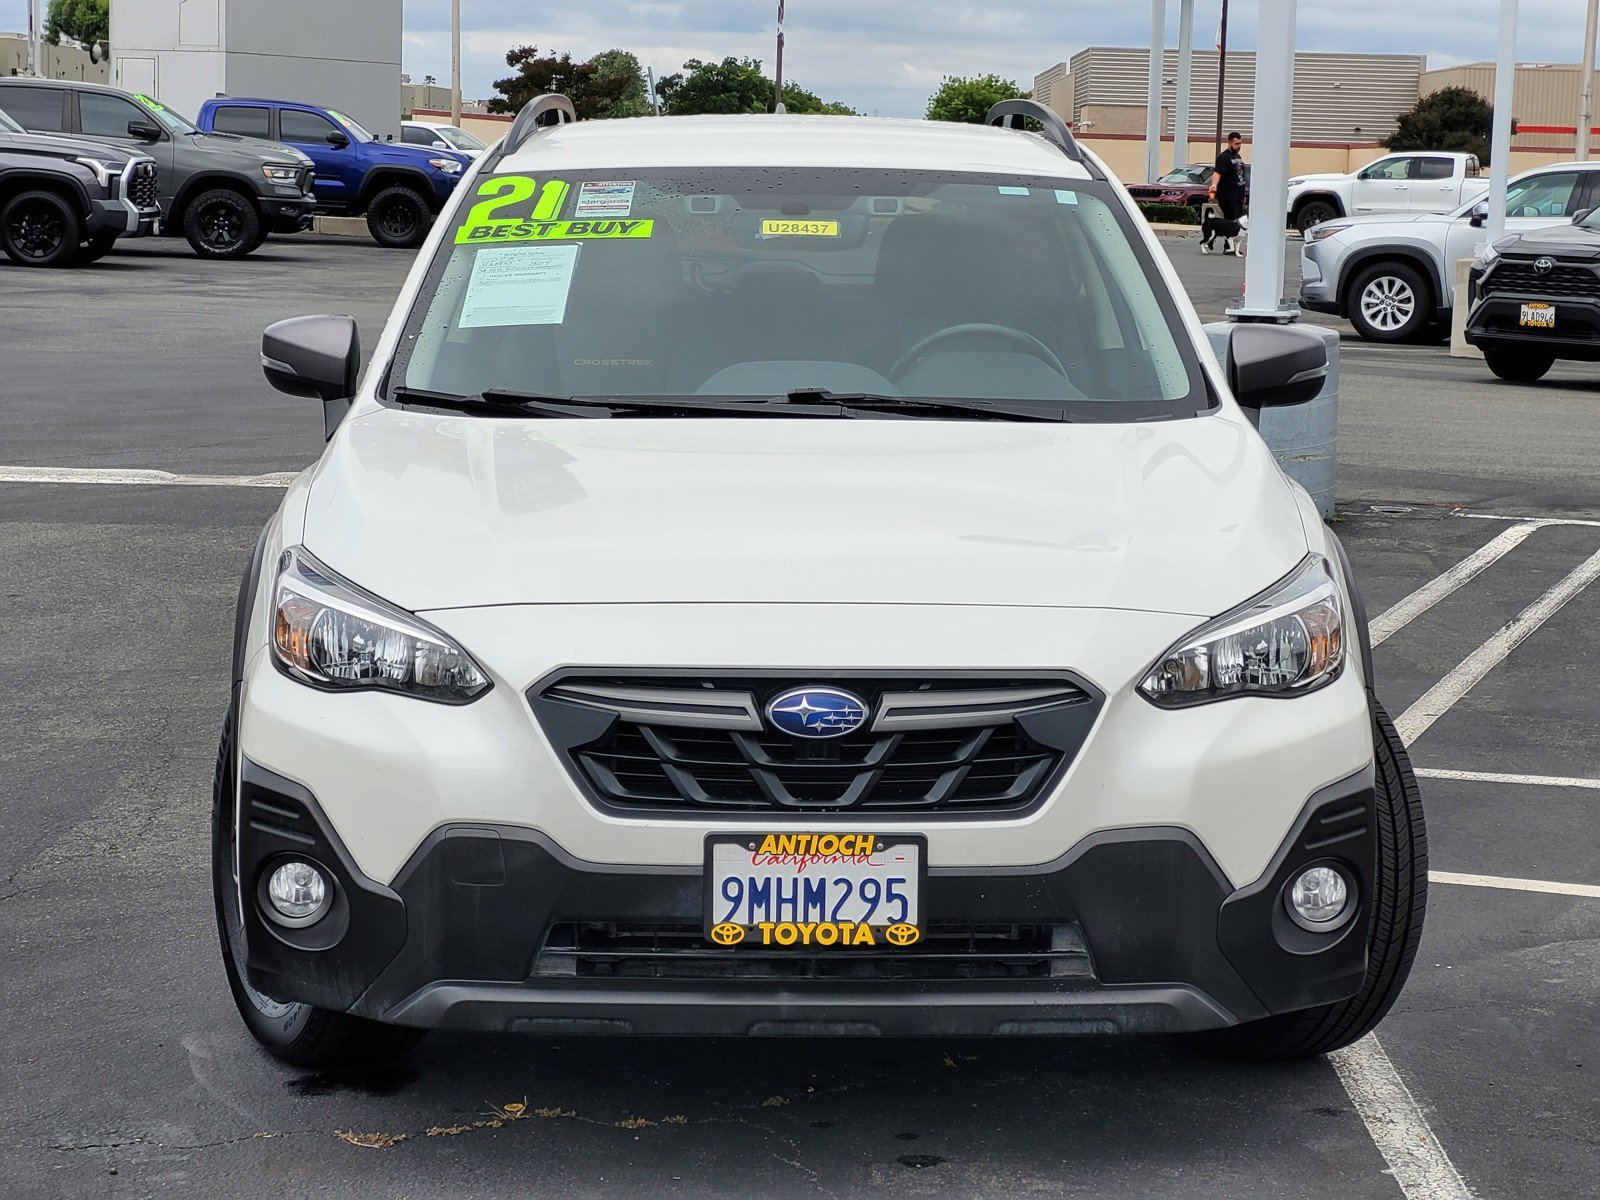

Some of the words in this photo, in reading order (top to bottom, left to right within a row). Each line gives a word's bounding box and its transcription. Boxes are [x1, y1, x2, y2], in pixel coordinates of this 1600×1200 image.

[467, 176, 569, 223] 21
[467, 223, 561, 240] BEST
[565, 221, 645, 236] BUY
[769, 223, 829, 233] U28437
[758, 834, 875, 855] ANTIOCH
[721, 876, 909, 924] 9MHM295
[758, 922, 876, 946] TOYOTA
